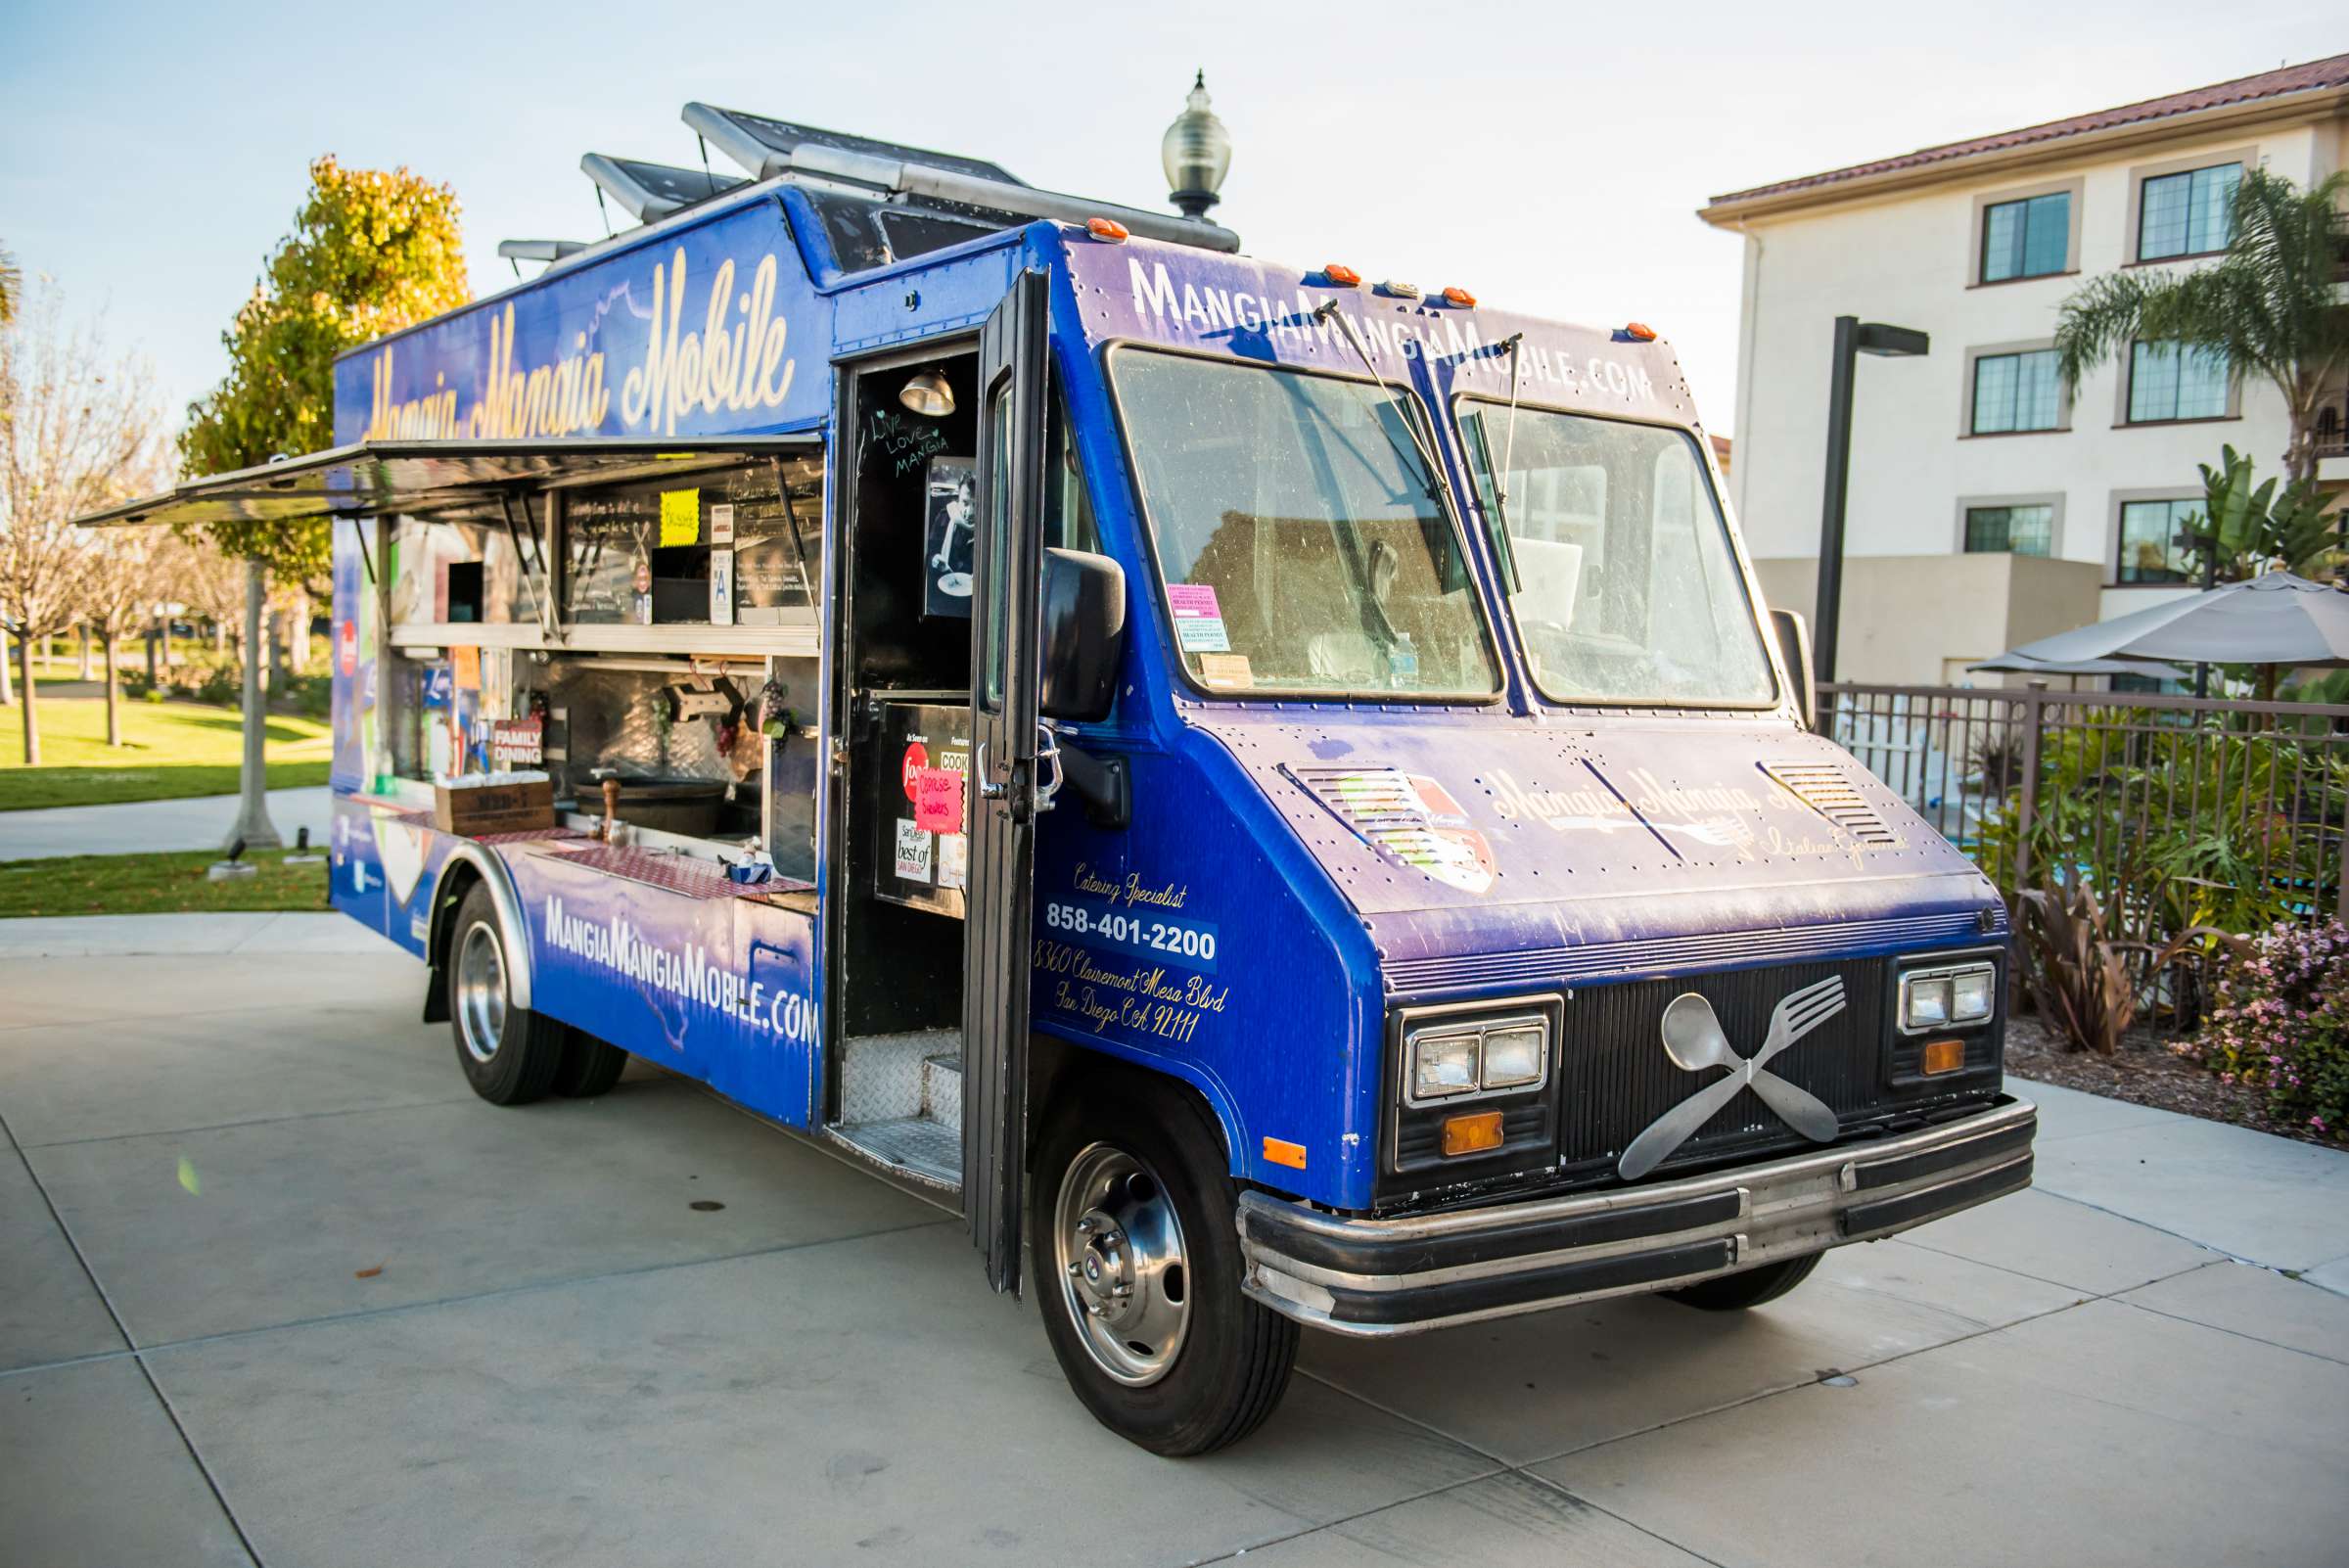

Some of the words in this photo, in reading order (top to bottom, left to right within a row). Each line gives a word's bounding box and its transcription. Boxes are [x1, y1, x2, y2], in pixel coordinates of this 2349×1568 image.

[470, 300, 610, 439] Mangia
[622, 246, 796, 438] Mobile
[715, 569, 726, 600] A
[494, 729, 542, 747] FAMILY
[494, 747, 542, 763] DINING
[898, 840, 917, 861] best
[918, 846, 930, 870] of
[1758, 826, 1839, 857] Italian
[898, 860, 907, 872] SAN
[1074, 861, 1121, 904] Catering
[1124, 872, 1187, 908] Specialist
[1046, 902, 1216, 960] 858-401-2200
[1033, 939, 1072, 973] 8360
[1072, 945, 1140, 992] Clairemont
[1139, 967, 1182, 1003] Mesa
[1185, 975, 1229, 1013] Blvd
[1055, 980, 1079, 1011] San
[1080, 987, 1120, 1034] Diego
[1121, 996, 1153, 1031] CA
[1151, 1005, 1201, 1043] 92111
